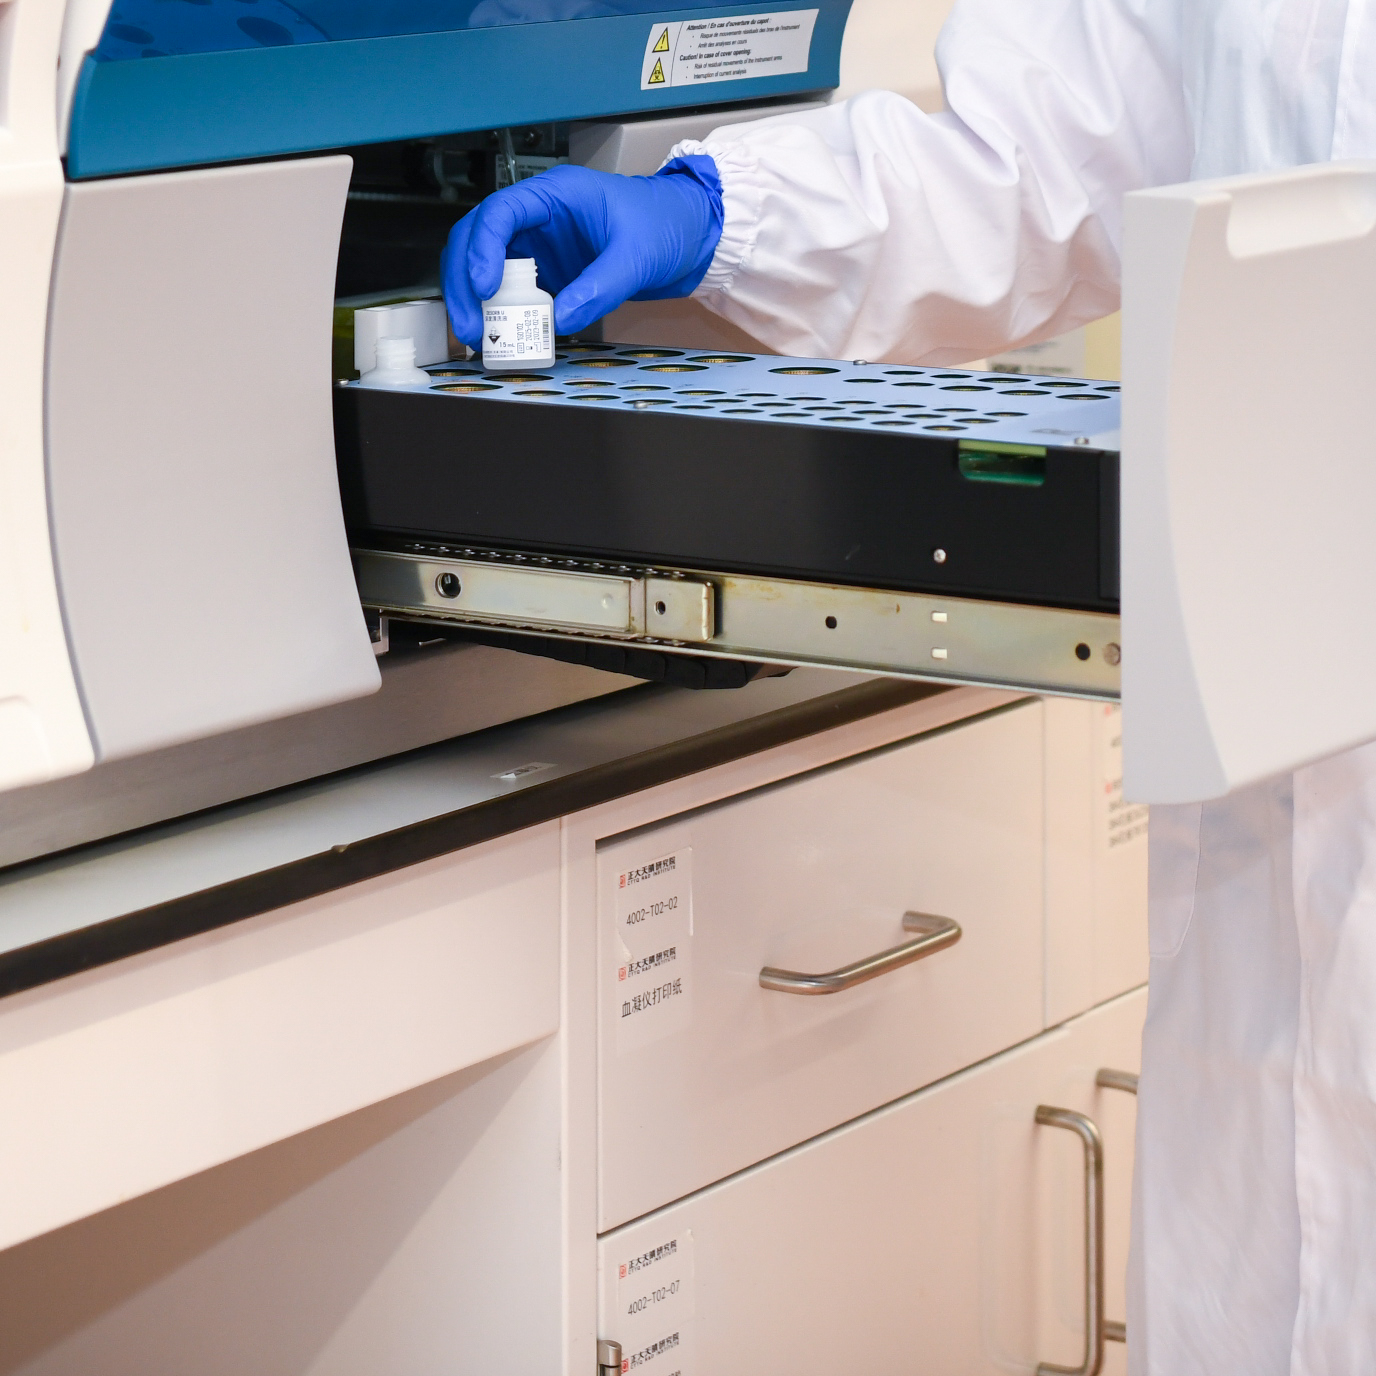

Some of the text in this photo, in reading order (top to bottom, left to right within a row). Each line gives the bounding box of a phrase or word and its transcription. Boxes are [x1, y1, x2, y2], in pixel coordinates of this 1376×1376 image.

[626, 896, 678, 925] 4002-T02-02
[621, 978, 683, 1018] 血凝仪打印纸
[627, 1279, 681, 1316] 4002-T02-07
